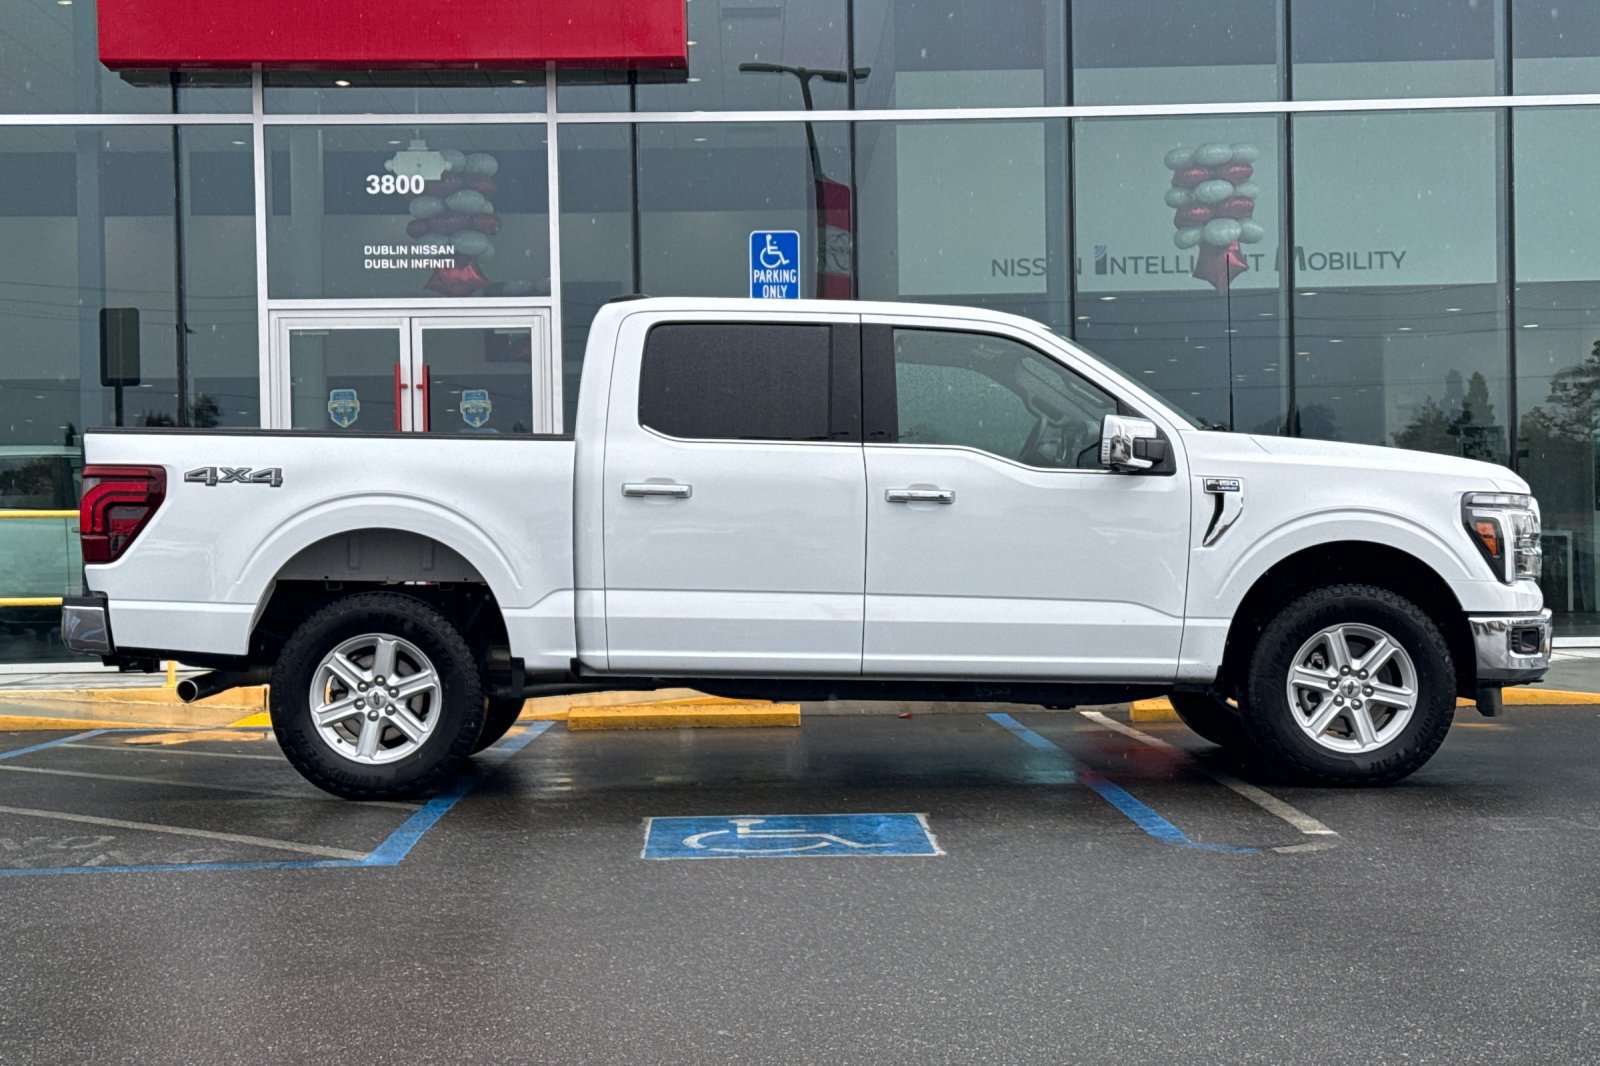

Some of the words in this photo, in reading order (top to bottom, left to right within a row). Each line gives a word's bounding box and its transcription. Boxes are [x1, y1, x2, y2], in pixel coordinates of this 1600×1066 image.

[366, 174, 425, 195] 3800
[364, 245, 408, 255] DUBLIN
[411, 245, 455, 255] NISSAN
[364, 259, 408, 269] DUBLIN
[411, 259, 455, 269] INFINITI
[992, 257, 1081, 277] NISS
[1094, 245, 1264, 275] INTELLIT
[753, 269, 797, 284] PARKING
[762, 285, 788, 298] ONLY
